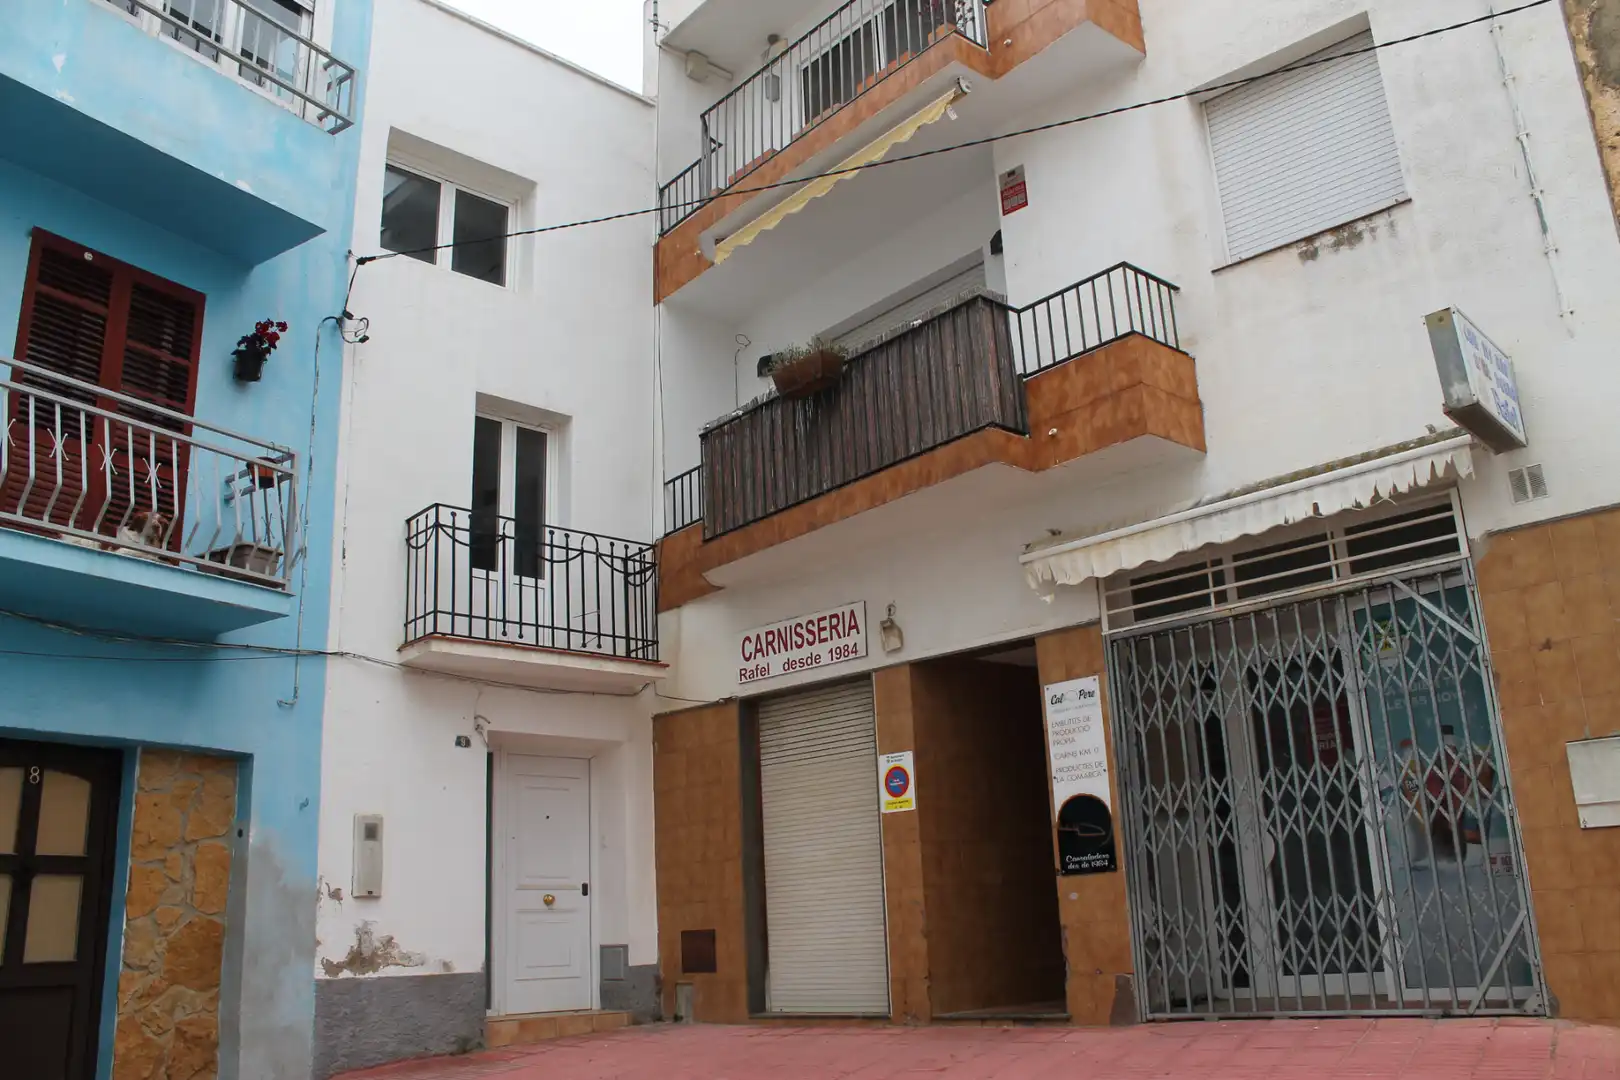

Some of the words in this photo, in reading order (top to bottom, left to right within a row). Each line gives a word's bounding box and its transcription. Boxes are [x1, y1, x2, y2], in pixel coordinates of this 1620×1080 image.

[742, 609, 860, 662] CARNISSERIA
[739, 664, 770, 681] Rafel
[782, 652, 821, 672] desde
[828, 642, 858, 661] 1984
[1051, 693, 1064, 705] Cal
[30, 766, 39, 784] 8
[1067, 771, 1102, 781] COMARCA
